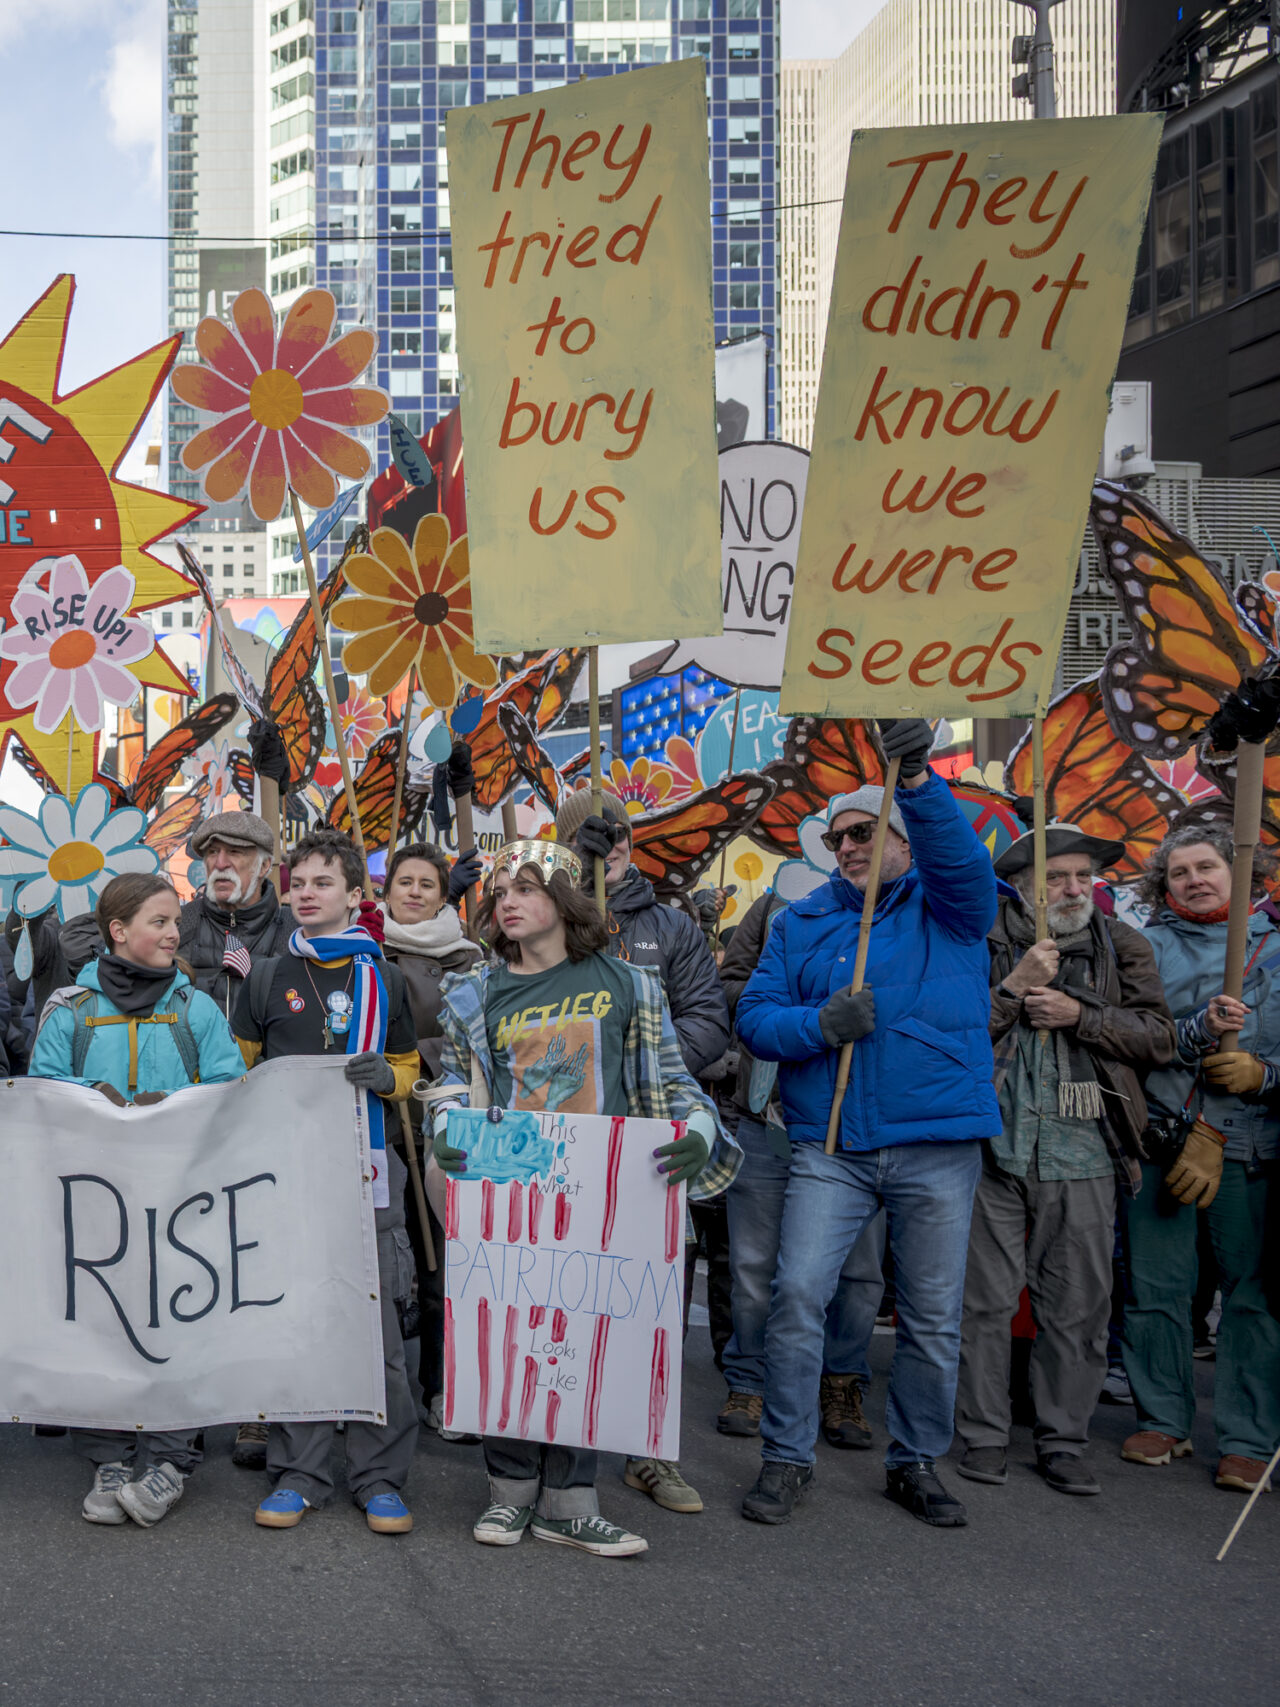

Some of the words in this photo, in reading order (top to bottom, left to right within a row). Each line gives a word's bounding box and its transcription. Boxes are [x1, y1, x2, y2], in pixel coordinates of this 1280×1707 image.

[492, 108, 652, 202] They
[887, 149, 1090, 259] They
[477, 194, 663, 288] tried
[526, 296, 596, 356] to
[862, 252, 1090, 350] didn't
[498, 376, 654, 461] bury
[854, 366, 1060, 444] know
[391, 429, 424, 487] ICE
[528, 485, 626, 540] us
[720, 477, 798, 543] NO
[881, 466, 987, 519] we
[723, 557, 796, 625] NG
[831, 543, 1019, 595] were
[24, 594, 88, 641] RISE
[93, 604, 134, 655] UP!
[807, 617, 1043, 703] seeds
[720, 701, 792, 740] PEAC
[641, 941, 658, 950] Rab
[496, 1002, 560, 1051] WET
[556, 989, 613, 1033] LEG
[535, 1112, 577, 1144] This
[534, 1170, 584, 1197] What
[58, 1173, 285, 1364] RISE
[530, 1330, 576, 1360] Looks
[534, 1362, 578, 1391] Like
